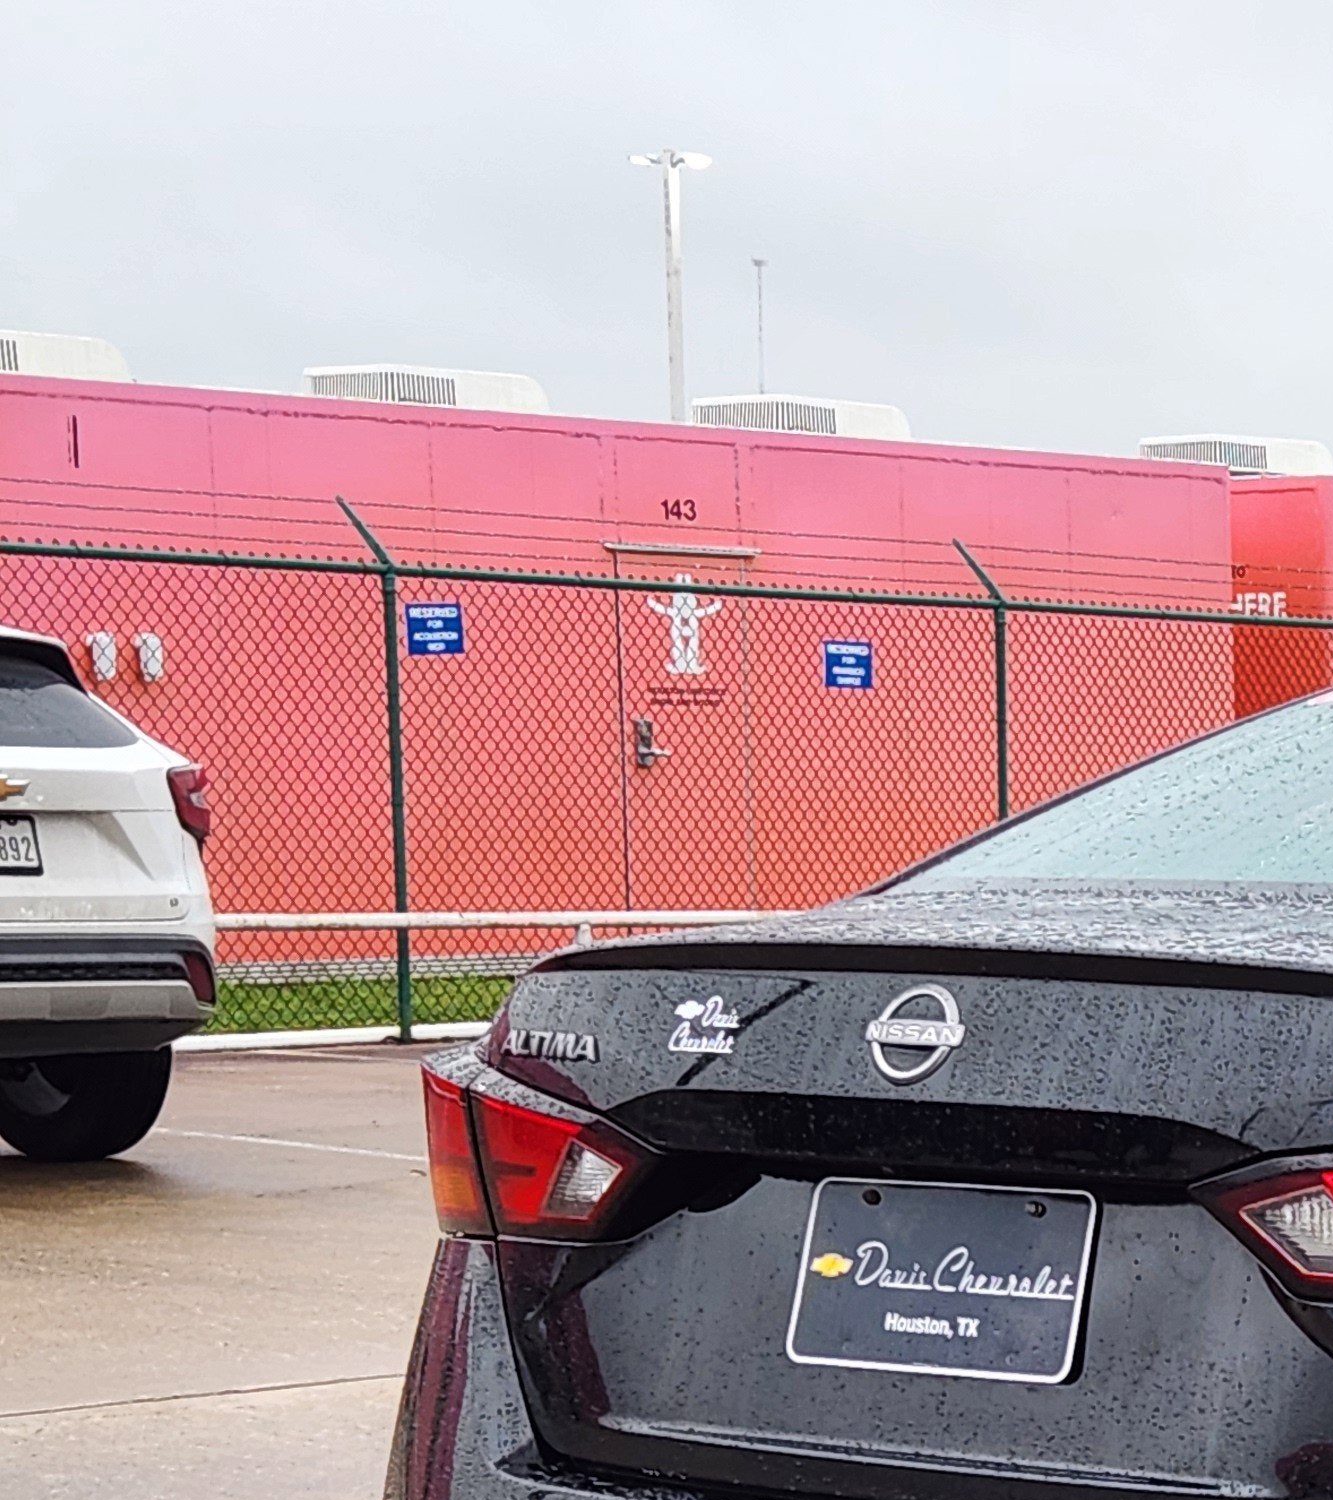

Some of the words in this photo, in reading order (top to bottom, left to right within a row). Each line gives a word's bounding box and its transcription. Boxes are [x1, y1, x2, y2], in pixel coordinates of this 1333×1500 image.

[660, 498, 697, 521] 143
[501, 1029, 597, 1062] ALTIMA
[868, 1023, 962, 1046] NISSAN
[854, 1240, 933, 1291] Davis
[932, 1246, 1075, 1300] Chevrolet
[884, 1312, 954, 1340] Houston,
[956, 1316, 981, 1338] TX
